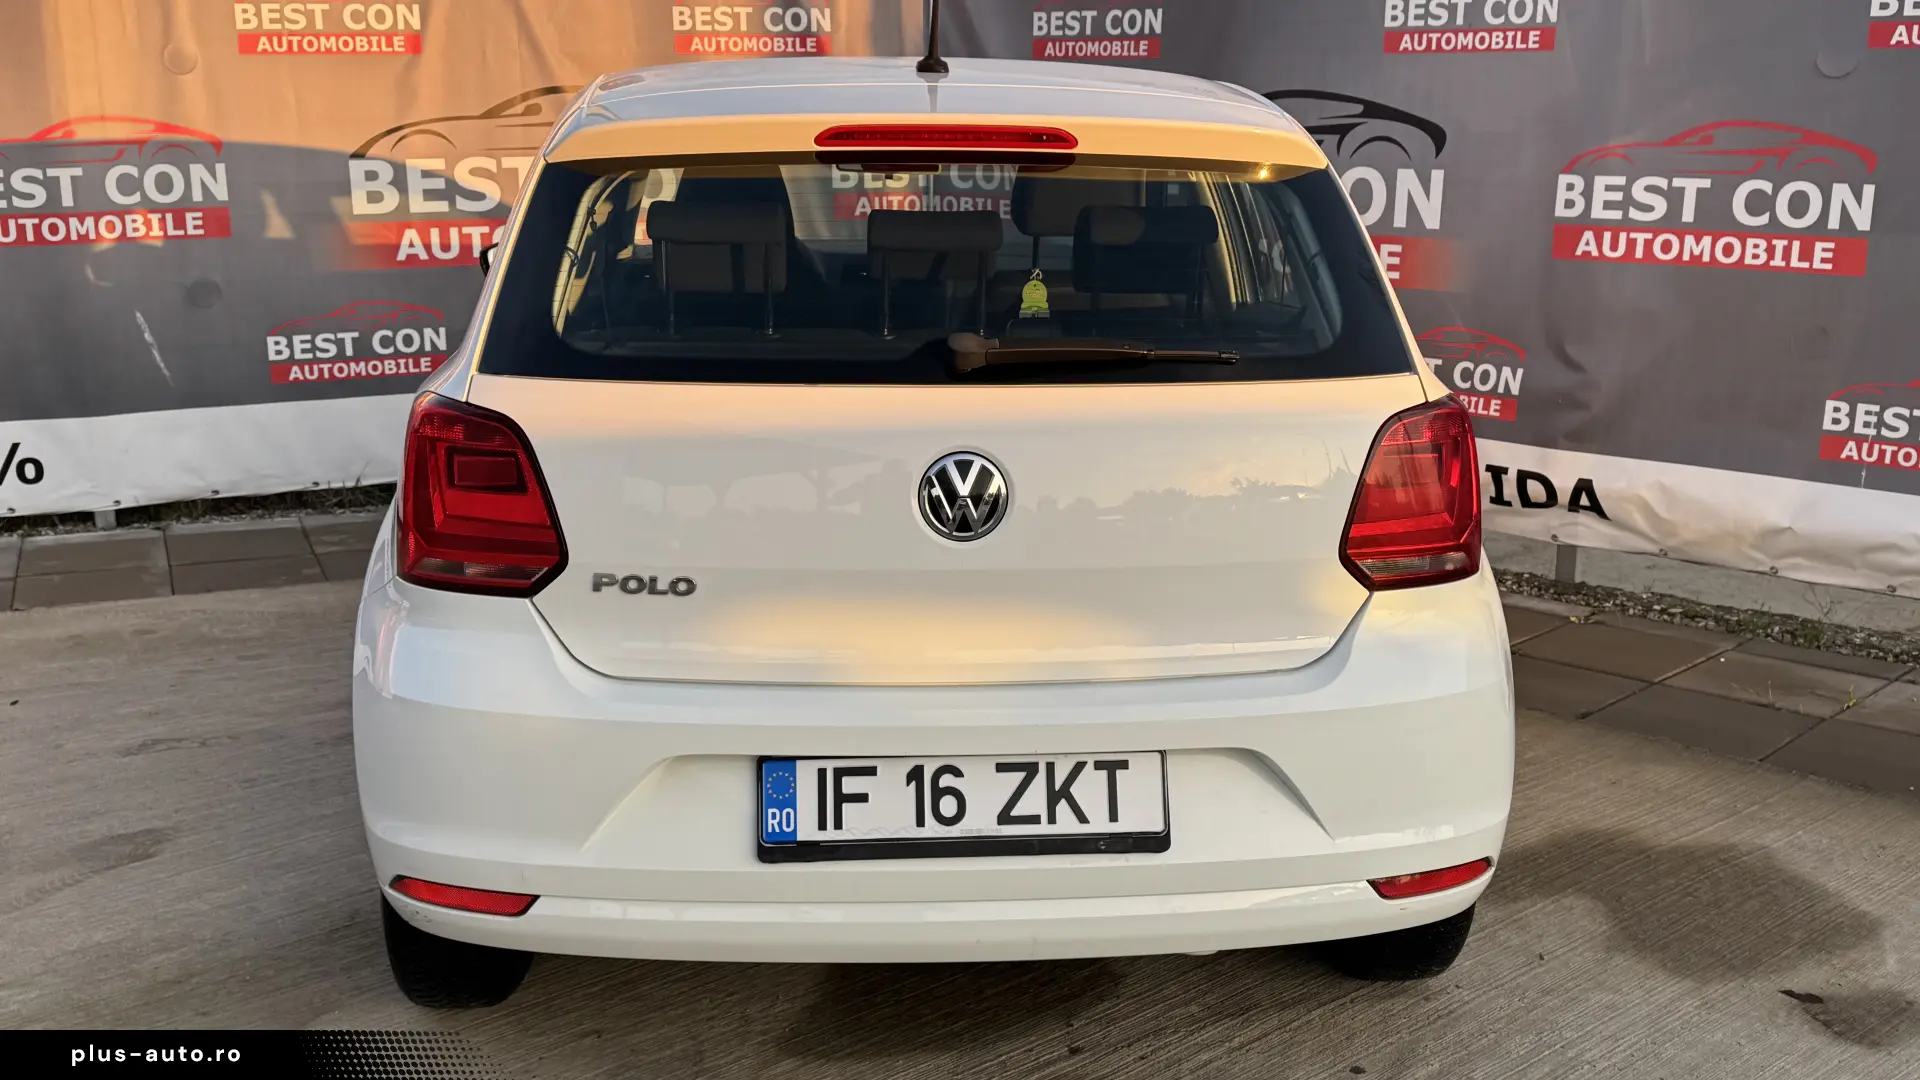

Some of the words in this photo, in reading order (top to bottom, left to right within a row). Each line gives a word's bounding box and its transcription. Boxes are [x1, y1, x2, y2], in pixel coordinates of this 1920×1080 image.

[234, 2, 329, 31] BEST
[342, 3, 421, 31] CON
[672, 6, 751, 33] BEST
[763, 6, 832, 33] CON
[1032, 9, 1097, 37] BEST
[1105, 8, 1162, 36] CON
[1384, 0, 1472, 28] BEST
[1483, 0, 1559, 25] CON
[256, 35, 406, 53] AUTOMOBILE
[690, 37, 818, 53] AUTOMOBILE
[1044, 40, 1148, 58] AUTOMOBILE
[1399, 30, 1540, 52] AUTOMOBILE
[0, 167, 83, 209] ST
[104, 162, 229, 206] CON
[1554, 173, 1711, 223] BEST
[1731, 179, 1877, 231] CON
[1574, 230, 1836, 271] AUTOMOBILE
[266, 330, 361, 362] BEST
[371, 326, 448, 356] CON
[288, 356, 432, 382] AUTOMOBILE
[1453, 361, 1524, 396] CON
[1823, 399, 1920, 439] BES
[1484, 463, 1613, 522] IDA
[592, 572, 698, 597] POLO
[817, 765, 878, 832] IF
[906, 763, 967, 829] 16
[995, 759, 1130, 827] ZKT
[766, 807, 795, 834] RO
